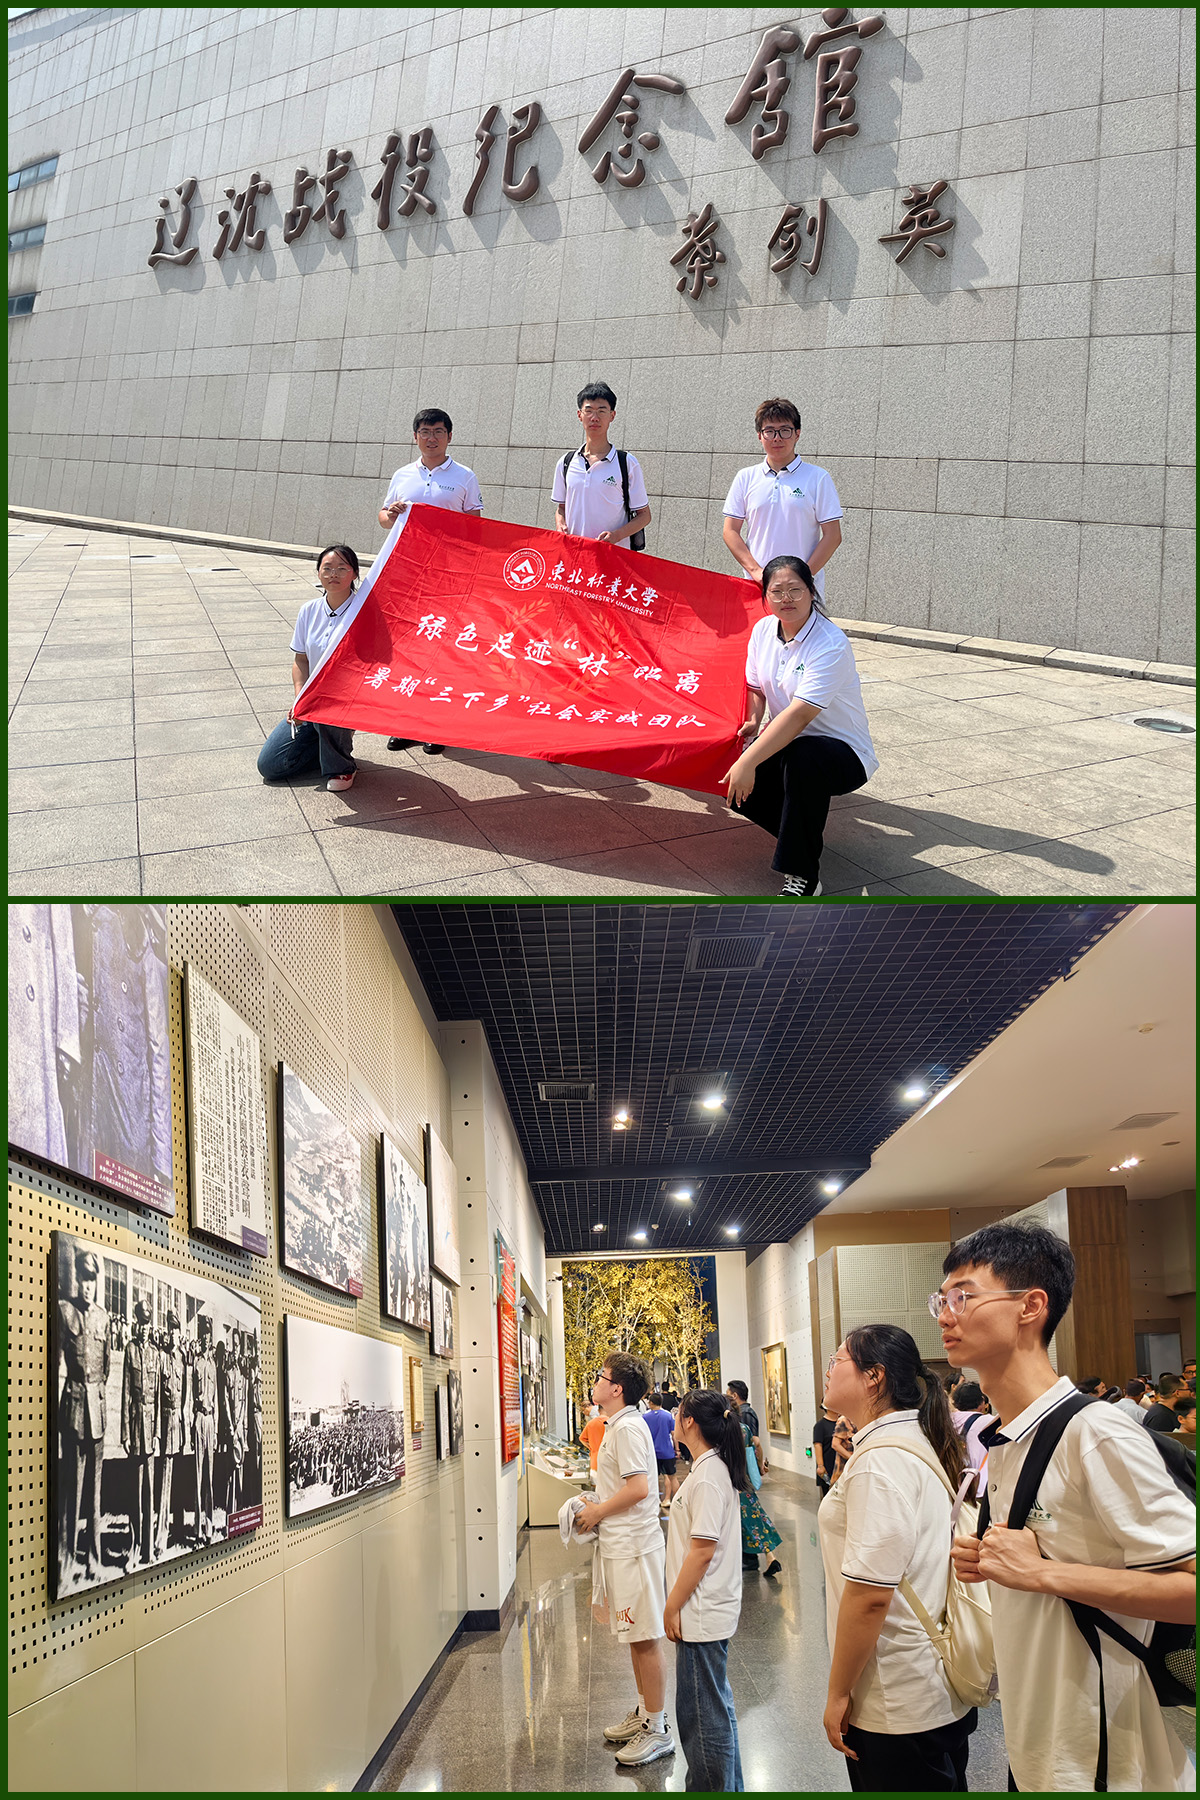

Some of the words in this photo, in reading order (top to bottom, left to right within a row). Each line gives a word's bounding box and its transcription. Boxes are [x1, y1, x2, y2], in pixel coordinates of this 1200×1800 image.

[545, 582, 583, 596] NORTHEAST
[583, 591, 614, 604] FORESTRY
[615, 600, 654, 616] UNIVERSITY
[364, 666, 706, 728] 暑期“三下乡”社会实践团队
